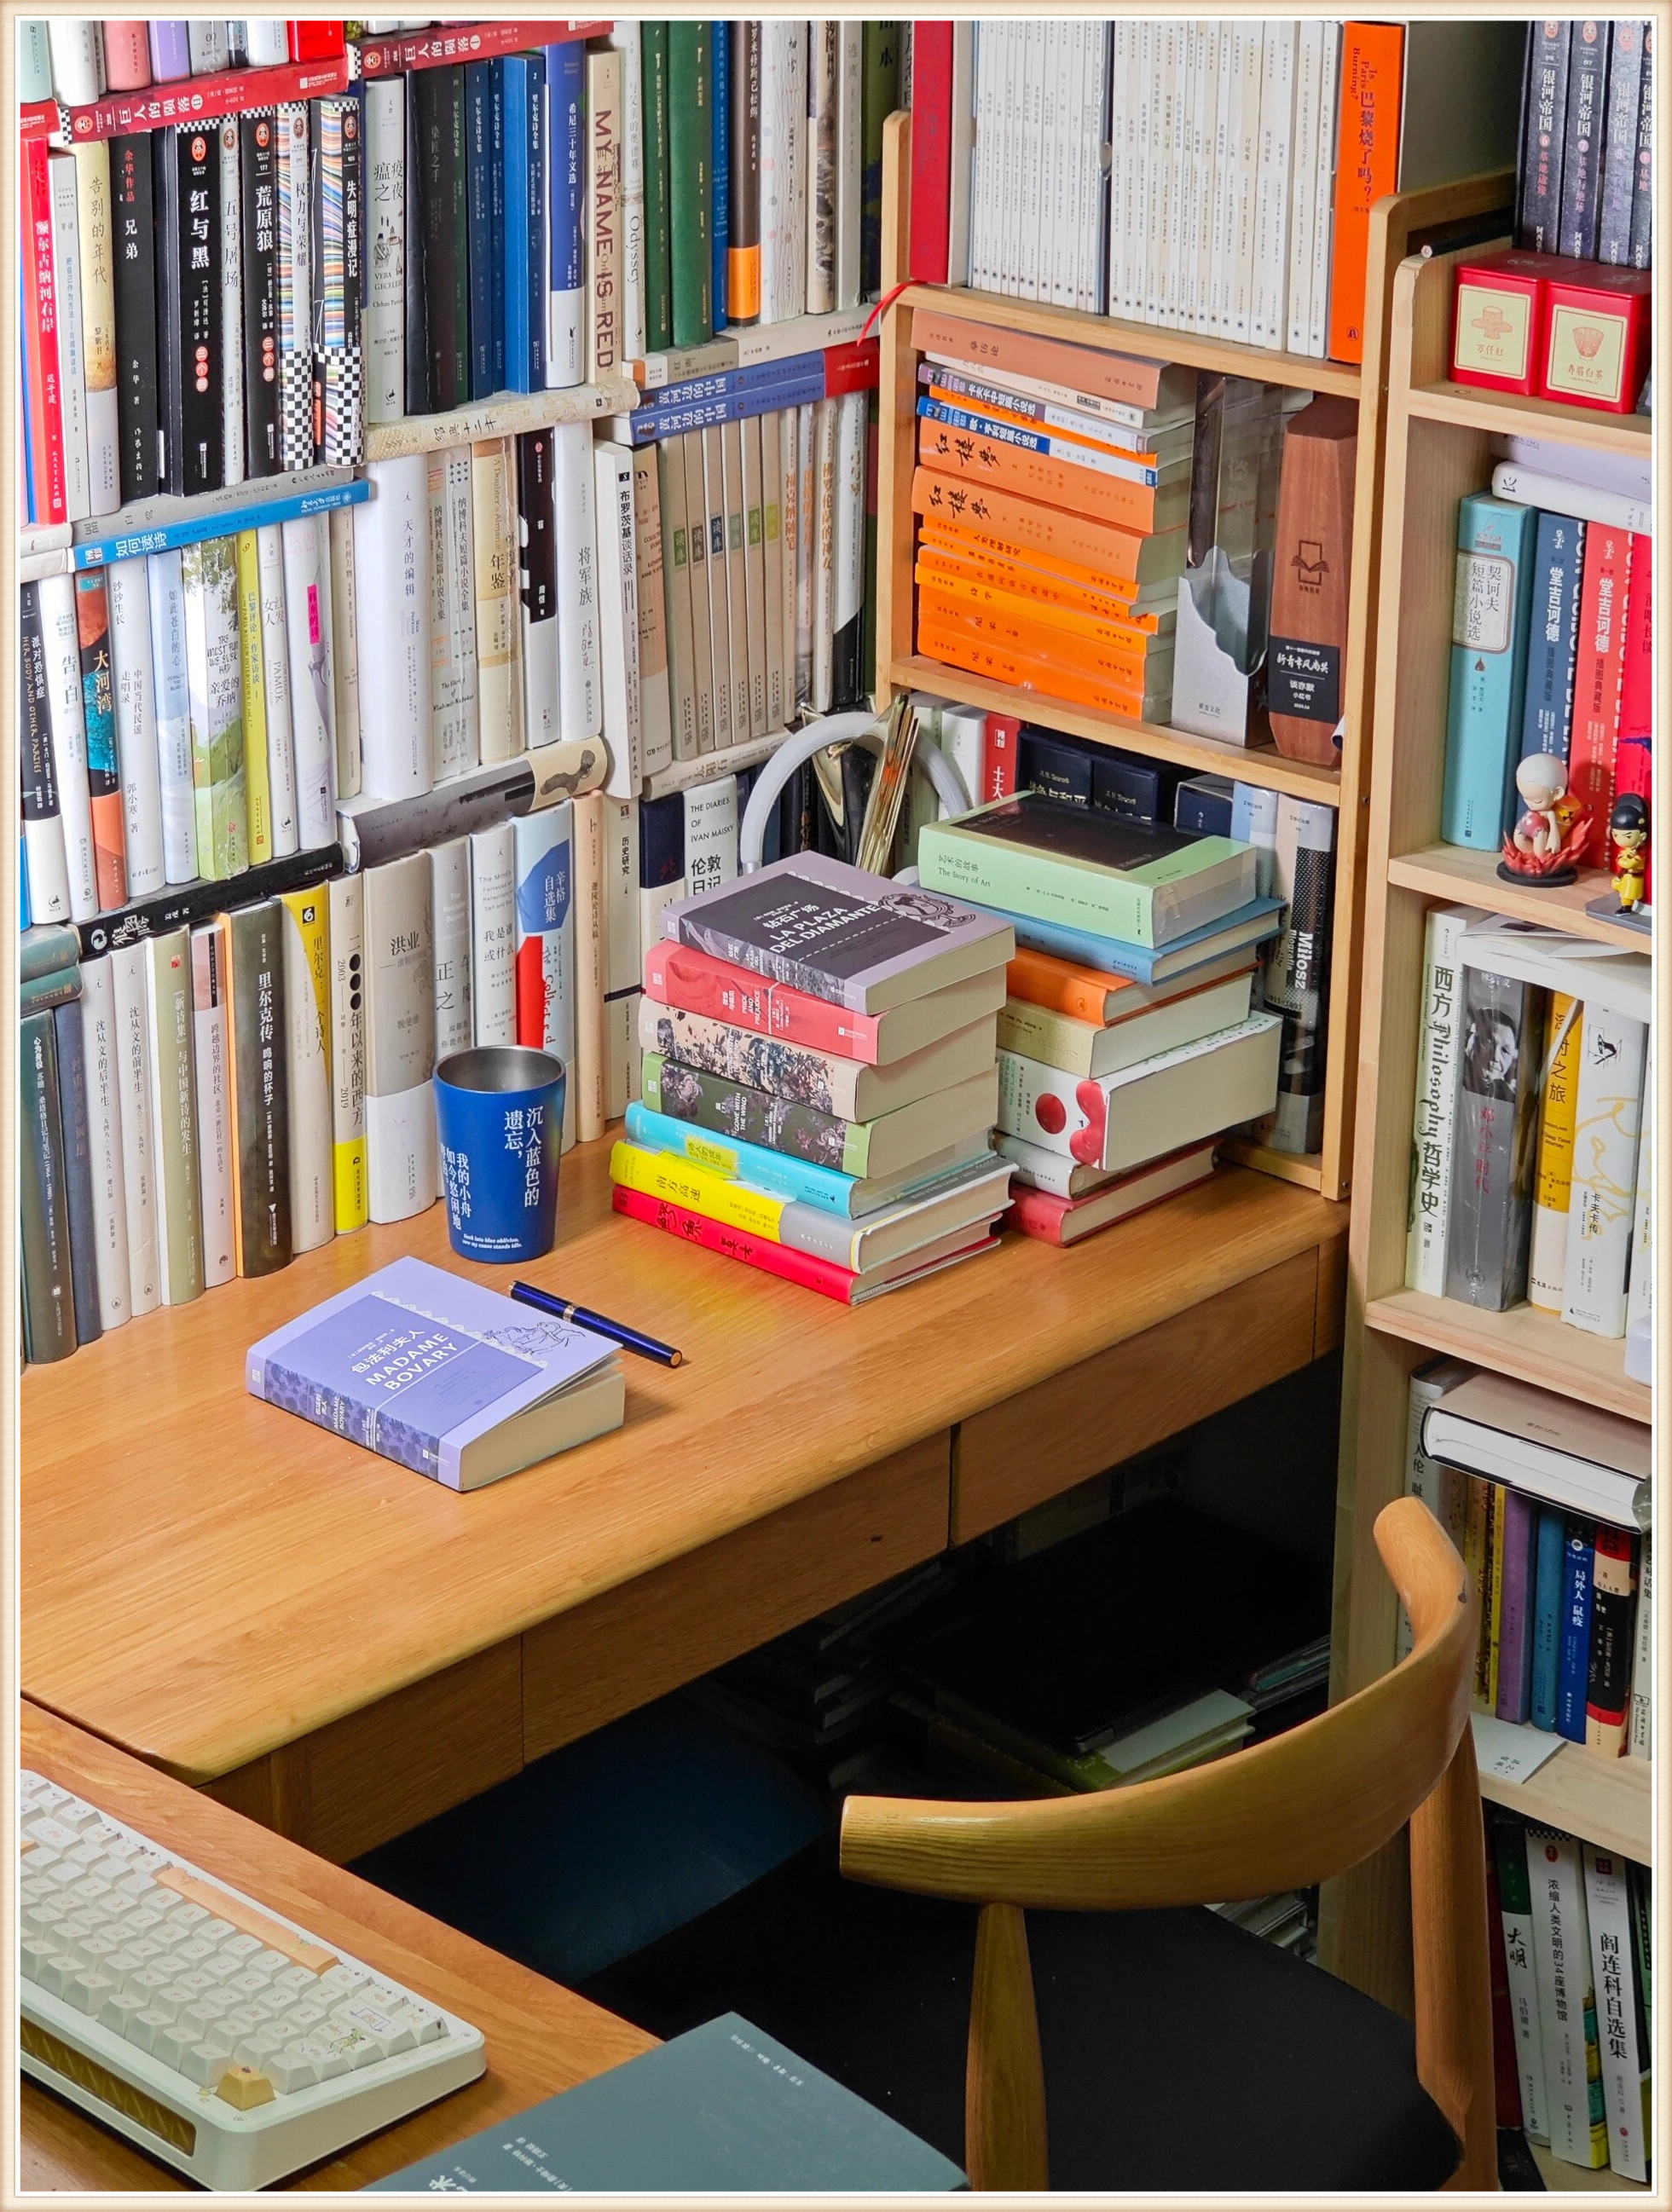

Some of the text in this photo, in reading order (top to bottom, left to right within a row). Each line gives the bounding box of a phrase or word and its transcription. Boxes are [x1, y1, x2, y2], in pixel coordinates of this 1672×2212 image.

[405, 34, 469, 62] 巨人的陨落
[1351, 48, 1360, 100] Burning?
[1369, 69, 1378, 80] Is
[119, 96, 190, 124] 巨人的陨落
[1538, 69, 1556, 132] 银河帝国
[1577, 74, 1594, 137] 银河帝国
[1614, 83, 1631, 144] 银河帝国
[431, 125, 440, 182] 染匠之手
[1358, 91, 1374, 202] 巴黎烧了吗？
[124, 150, 135, 203] 余华作品
[89, 176, 107, 283] 告别的年代
[124, 219, 138, 260] 兄弟
[189, 189, 211, 269] 红与黑
[256, 185, 274, 252] 荒原狼
[296, 182, 307, 267] 权力与荣耀
[346, 180, 358, 277] 失明症漫记
[596, 110, 613, 369] MY NAME IS RED
[223, 199, 240, 288] 五号屠场
[626, 215, 640, 286] Odyssey
[36, 221, 54, 333] 额尔古纳河右岸
[658, 377, 726, 405] 黄河边的中国
[968, 384, 1037, 416] 卡夫卡中短篇小说选
[658, 403, 726, 430] 黄河边的中国
[969, 418, 1038, 452] 欧·亨利短篇小说选
[934, 432, 1001, 469] 红楼梦
[929, 483, 992, 521] 红楼梦
[116, 531, 168, 558] 如何读诗
[458, 498, 469, 611] 纳博科夫短篇小说全集
[619, 489, 634, 575] 布罗茨基谈话录
[974, 534, 1021, 557] 人类理解研究
[403, 519, 415, 596] 天才的编辑
[434, 505, 445, 620] 纳博科夫短篇小说全集
[490, 554, 506, 589] 年鉴
[578, 546, 592, 606] 将军族
[113, 581, 124, 625] 沙沙生长
[970, 586, 992, 600] 诗学
[976, 570, 1060, 602] 在通向语言的途中
[1467, 562, 1486, 642] 短篇小说选
[1486, 564, 1502, 612] 契诃夫
[1546, 567, 1564, 643] 堂吉诃德
[169, 591, 182, 667] 如此苍白的心
[263, 599, 275, 627] 女人
[975, 616, 996, 632] 尼采
[1595, 577, 1614, 654] 堂吉诃德
[62, 656, 78, 705] 告白
[94, 650, 113, 714] 大河湾
[274, 661, 285, 704] PAMUK
[972, 651, 993, 667] 尼采
[1544, 647, 1555, 702] 插图典藏版
[22, 637, 42, 774] HER BODY AND OTHER PARTIES
[120, 671, 131, 704] 走唱录
[134, 669, 142, 735] 中国当代民谣
[211, 677, 240, 695] 亲爱的
[1293, 692, 1311, 701] 小红书
[1593, 658, 1605, 713] 插图典藏版
[126, 783, 138, 815] 郭小寒
[691, 797, 730, 813] THE DIARIES
[691, 819, 702, 828] OF
[691, 825, 734, 843] IVAN MAISKY
[691, 854, 721, 877] 伦敦
[693, 876, 721, 896] 日记
[938, 853, 980, 873] 艺术的故事
[938, 867, 991, 888] The Story of Art
[544, 875, 556, 923] 自选集
[556, 871, 566, 904] 辛格
[112, 915, 155, 946] 狼图腾
[762, 904, 820, 930] 钻石广场
[769, 904, 881, 955] DEL DIAMANTE
[770, 906, 849, 941] LA PLAZA
[390, 931, 419, 956] 洪业
[483, 944, 514, 962] 或什么
[1294, 931, 1313, 990] Miłosz
[258, 972, 273, 1042] 里尔克传
[1432, 965, 1455, 1018] 西方
[34, 1037, 43, 1069] 心为身役
[95, 1020, 110, 1107] 沈从文的后半生
[129, 1006, 143, 1094] 沈从文的前半生
[210, 1024, 223, 1094] 跨越边界的社区
[340, 1087, 349, 1108] 2019
[504, 1111, 524, 1160] 遗忘，
[524, 1106, 543, 1208] 沉入蓝色的
[1545, 1133, 1571, 1146] Deep Time
[1547, 1139, 1565, 1150] Journey
[446, 1147, 462, 1231] 如今悠闲地
[456, 1152, 472, 1219] 我的小舟
[656, 1175, 701, 1203] 南方高速
[1419, 1141, 1443, 1219] 哲学史
[1589, 1192, 1601, 1235] 卡夫卡传
[351, 1329, 425, 1374] 包法利夫人
[365, 1332, 449, 1386] MADAME
[384, 1343, 458, 1390] BOVARY
[1571, 1569, 1586, 1627] 局外人 鼠疫
[1507, 1927, 1527, 1970] 大明
[1547, 1879, 1568, 2023] 浓缩人类文明的34座博物馆
[1600, 1932, 1628, 2059] 阎连科自选集
